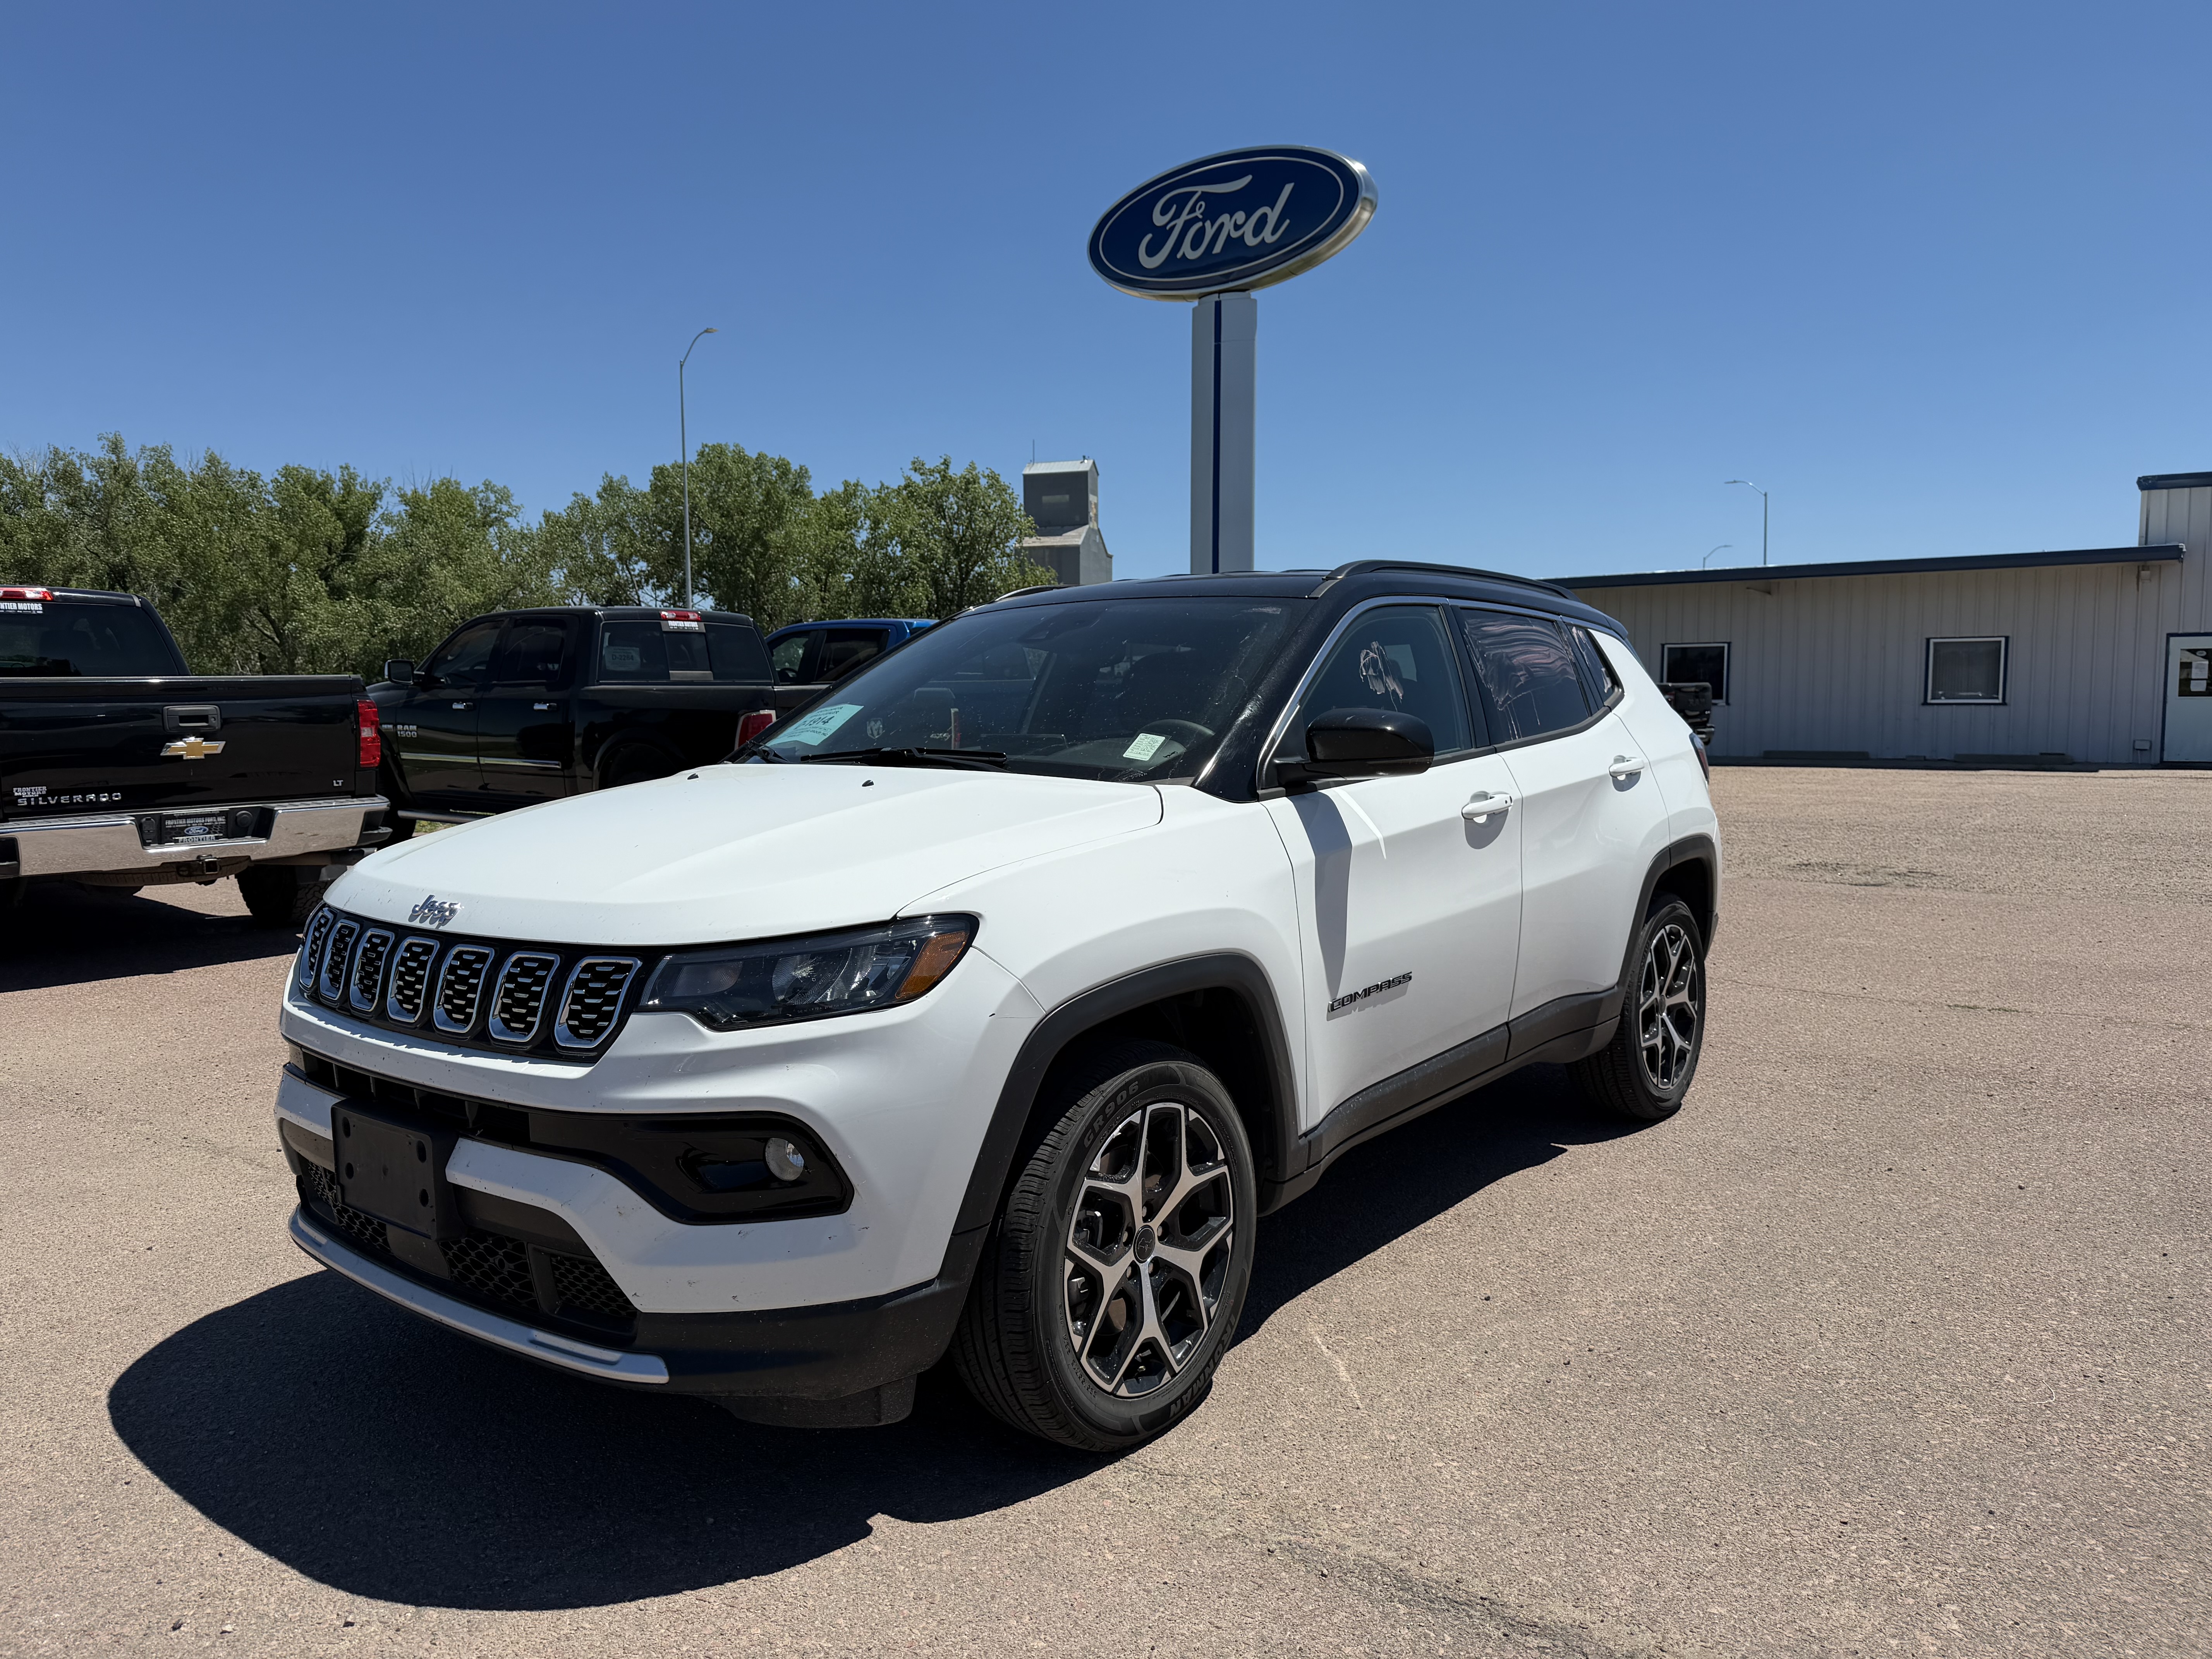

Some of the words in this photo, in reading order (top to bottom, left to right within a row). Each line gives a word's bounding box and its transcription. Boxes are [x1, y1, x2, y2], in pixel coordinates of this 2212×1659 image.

[1138, 174, 1295, 269] Ford
[17, 793, 121, 806] SILVERADO
[412, 895, 462, 924] Jeep
[1328, 971, 1412, 1012] COMPASS
[1084, 1081, 1139, 1148] GR906
[1169, 1314, 1236, 1418] IRONMAN
